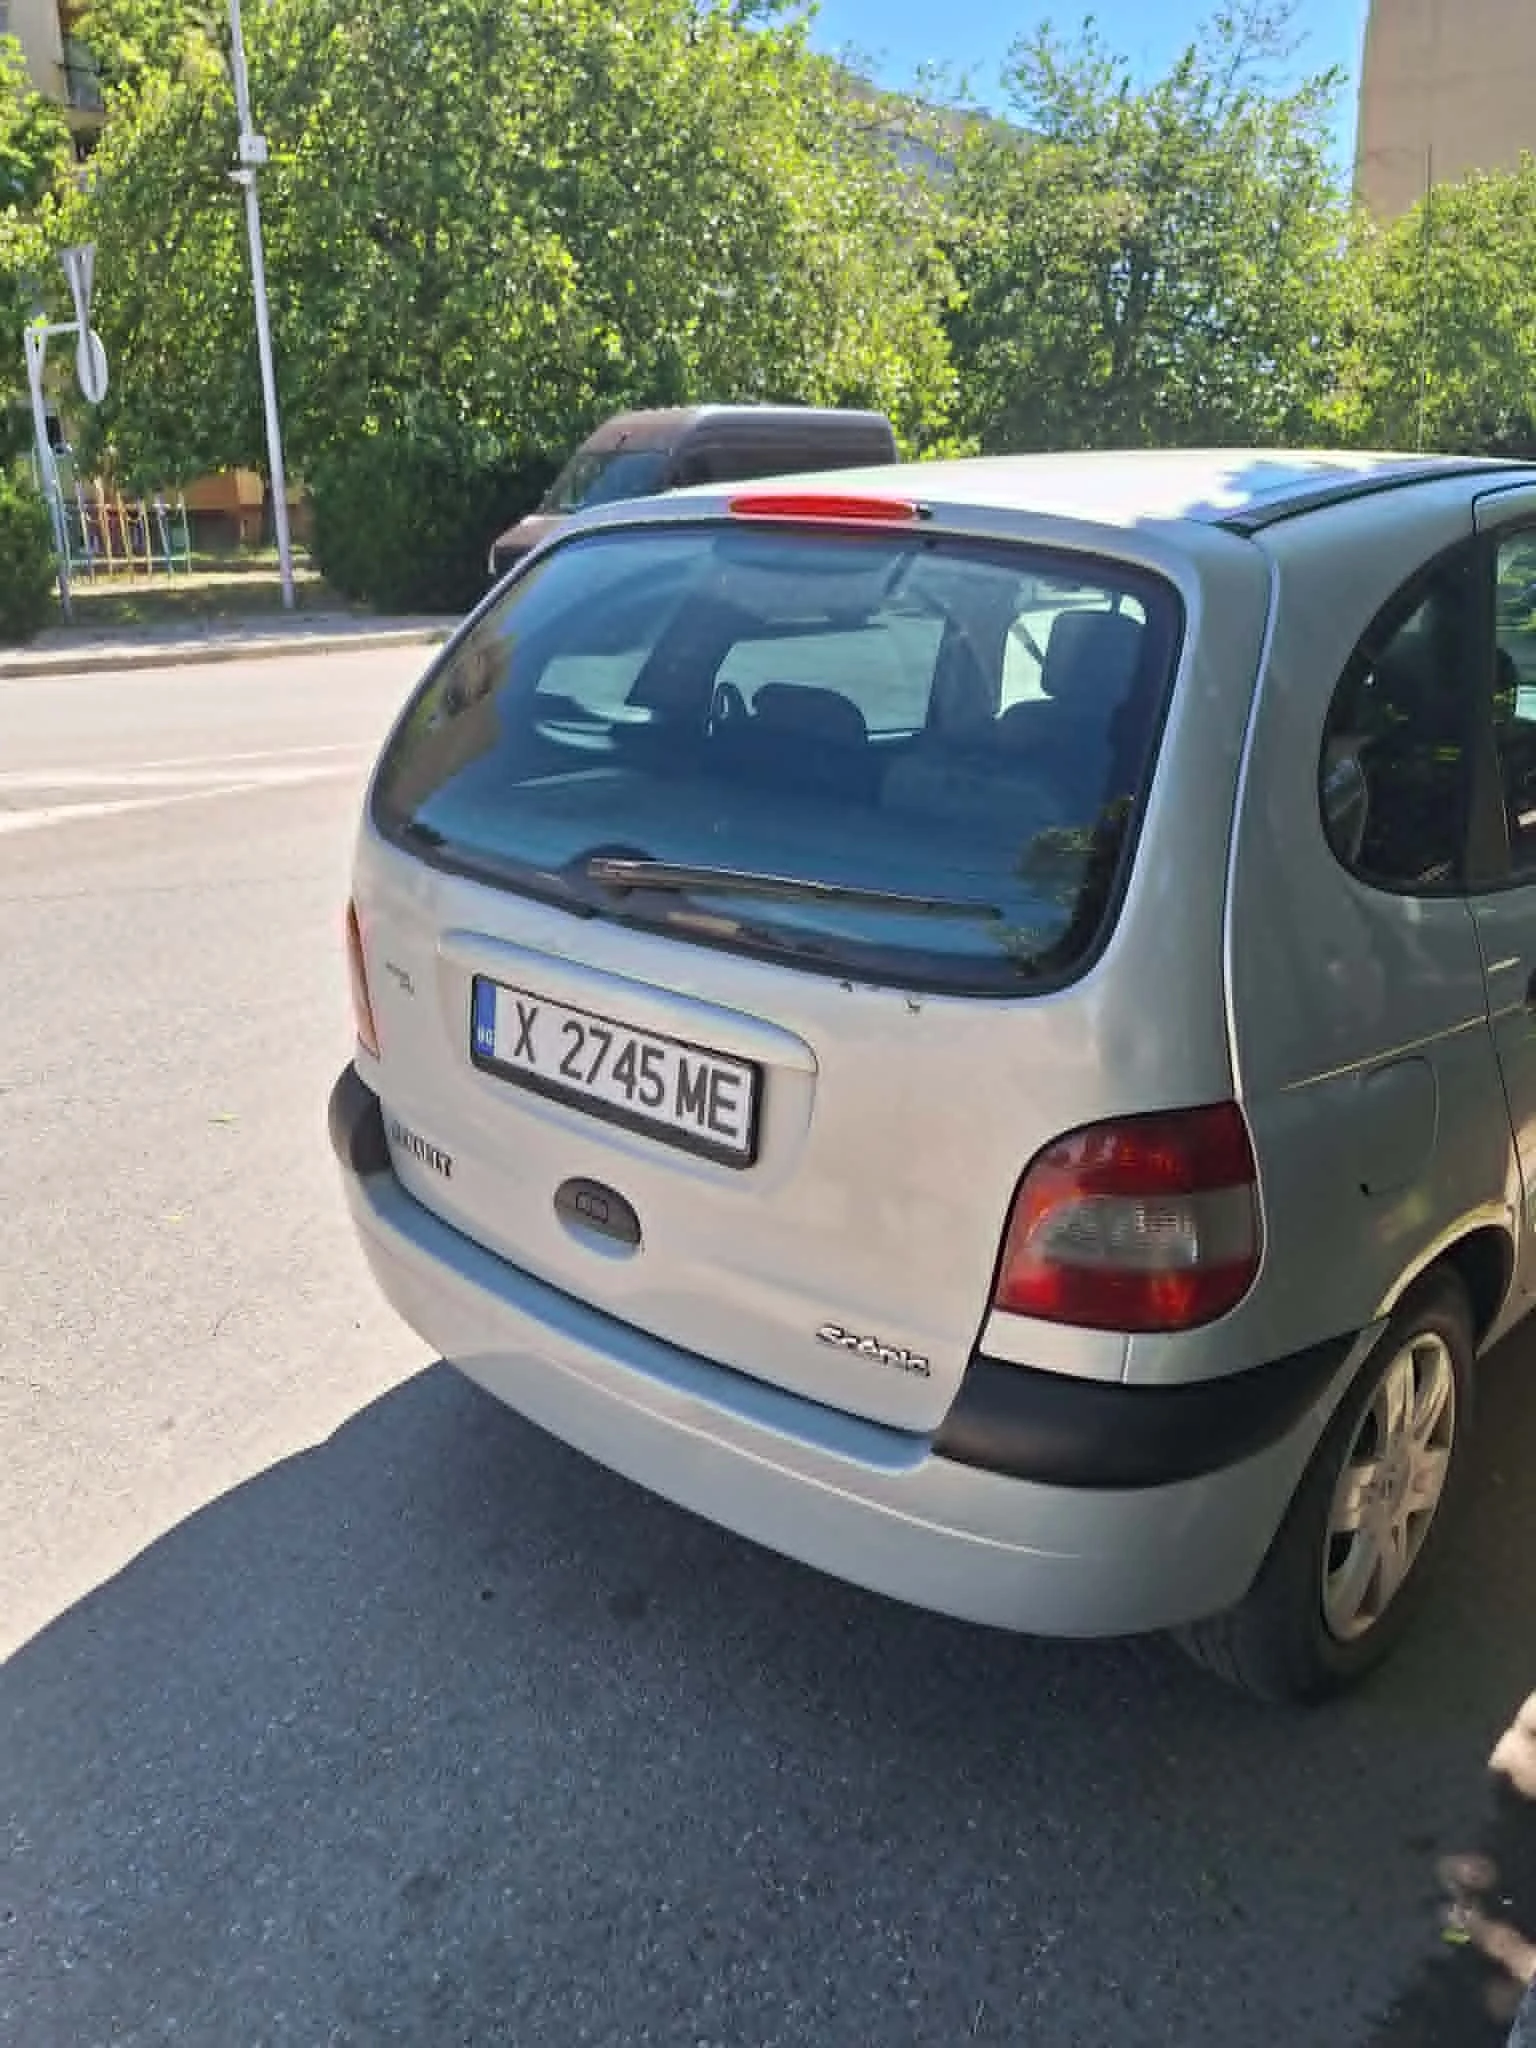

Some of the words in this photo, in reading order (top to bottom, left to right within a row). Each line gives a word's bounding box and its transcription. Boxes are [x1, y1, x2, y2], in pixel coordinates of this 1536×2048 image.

[514, 1001, 538, 1063] X
[560, 1021, 664, 1106] 2745
[676, 1057, 740, 1138] ME
